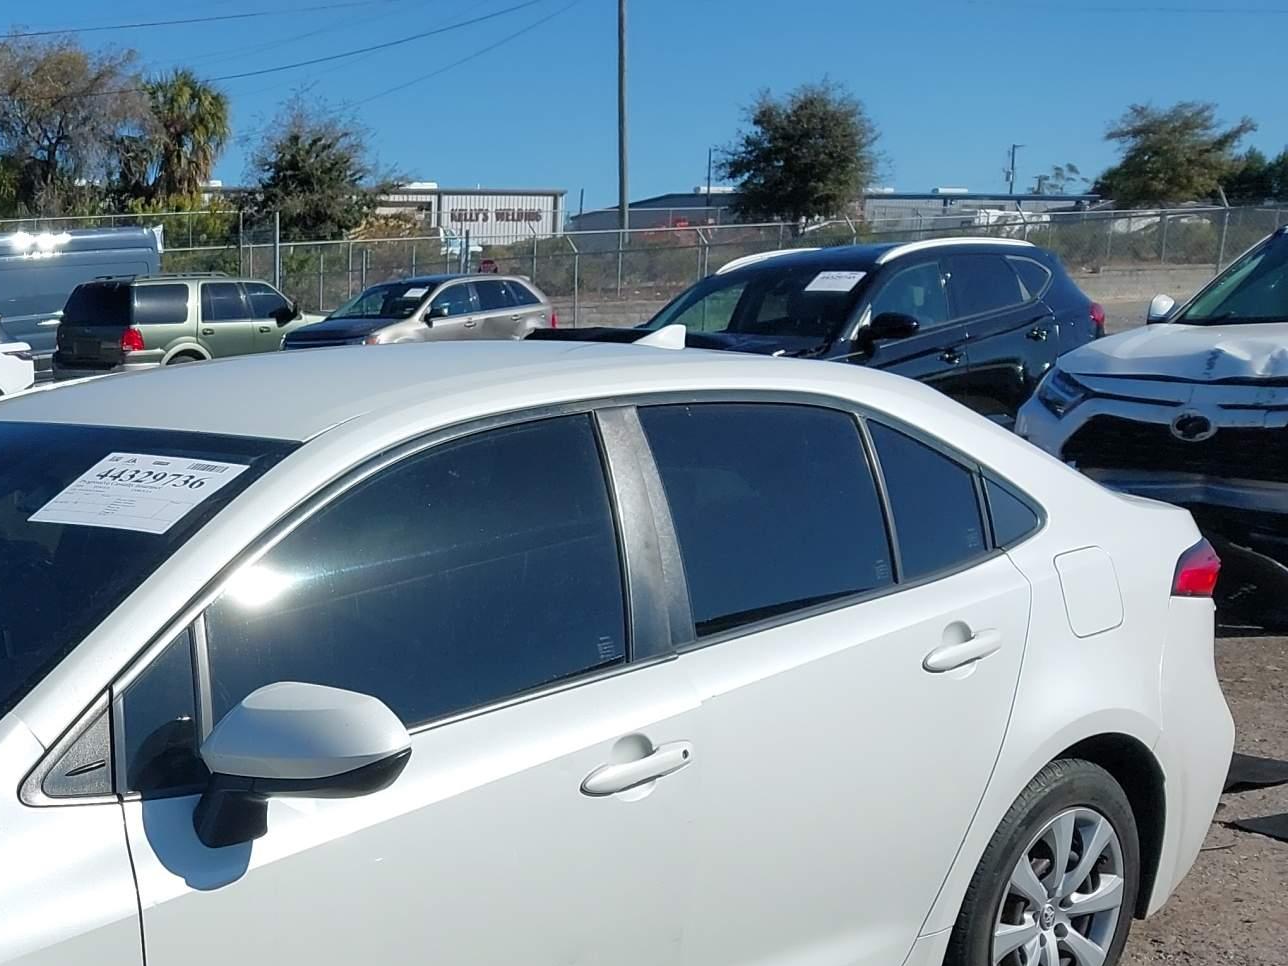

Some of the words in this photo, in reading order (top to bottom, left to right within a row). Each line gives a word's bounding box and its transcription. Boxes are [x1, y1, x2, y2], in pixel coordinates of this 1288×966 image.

[450, 208, 489, 222] KELLY'S
[495, 208, 541, 222] WELDING
[96, 467, 211, 490] 44329736
